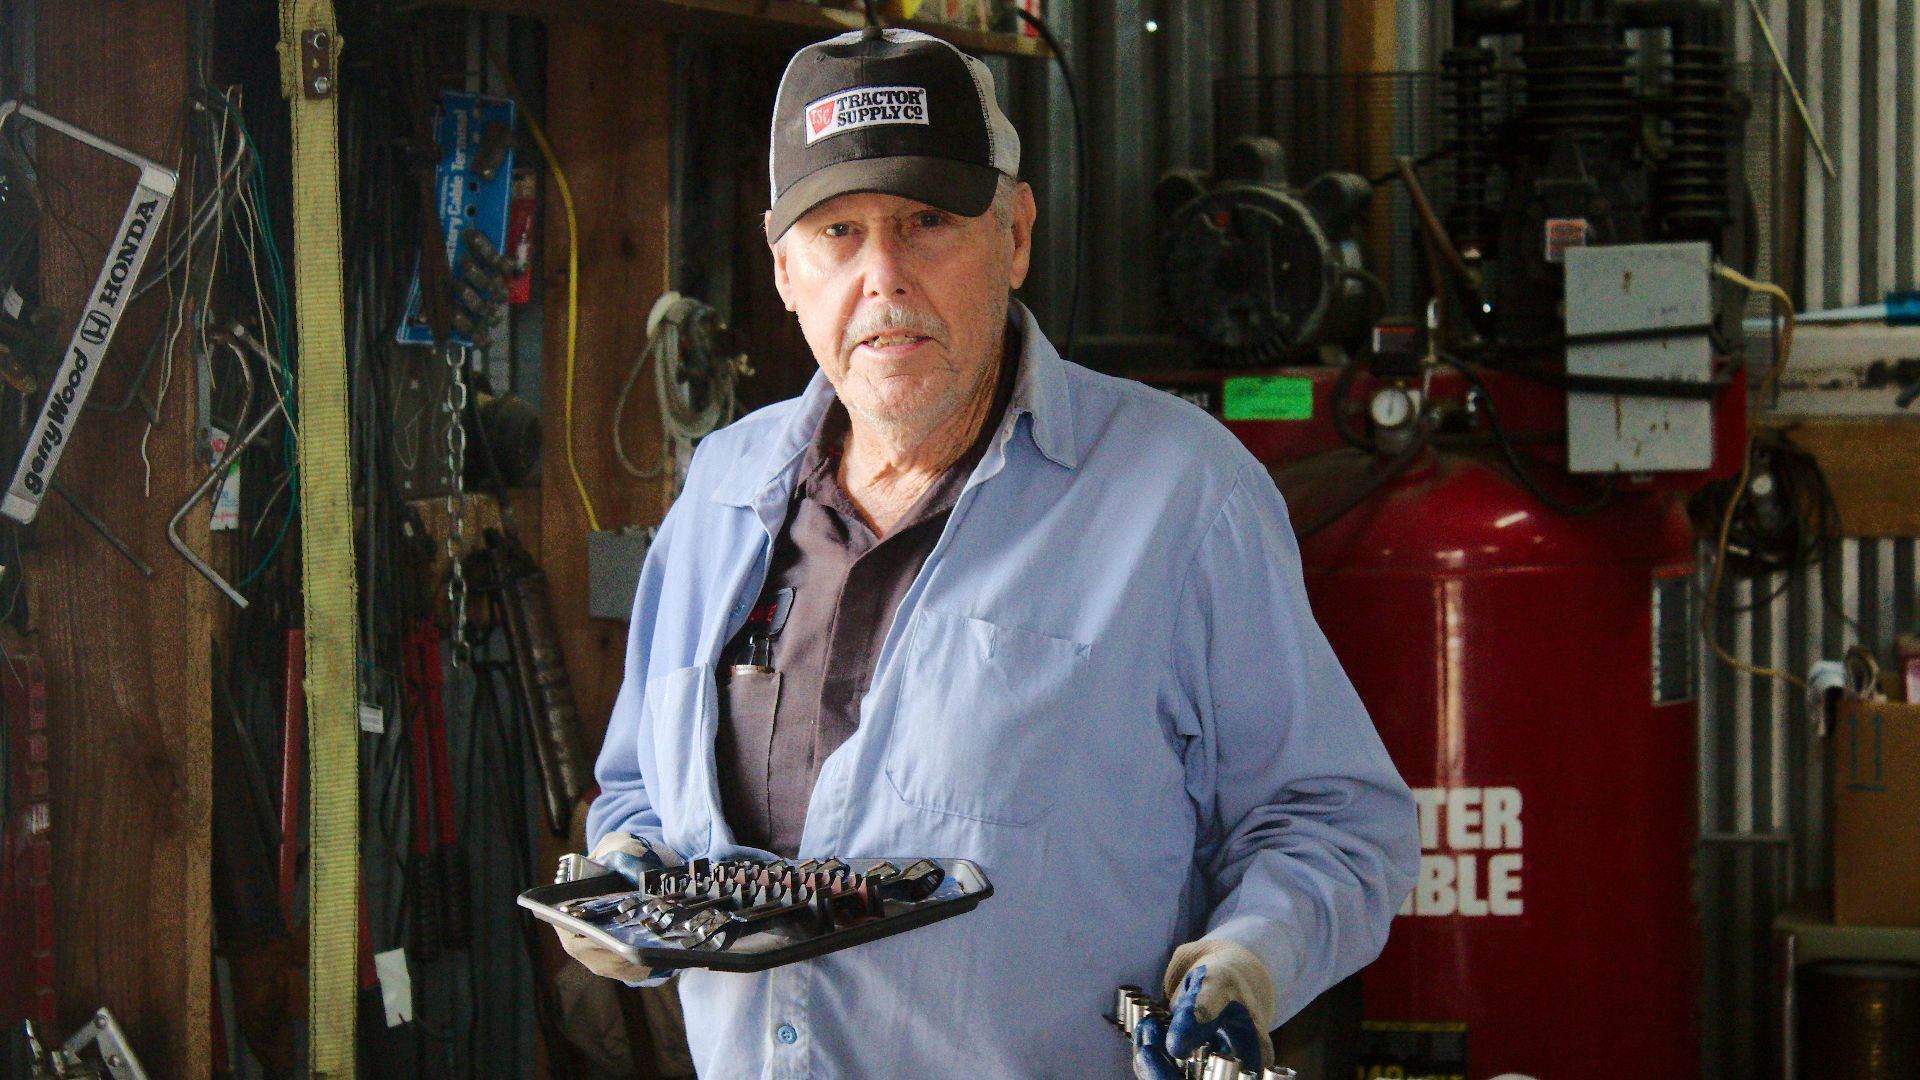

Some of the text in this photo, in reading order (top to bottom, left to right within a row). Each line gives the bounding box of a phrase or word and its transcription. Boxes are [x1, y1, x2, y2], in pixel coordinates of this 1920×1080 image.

[836, 90, 922, 112] TRACTOR
[837, 106, 902, 127] SUPPLY
[810, 108, 831, 126] TSC
[448, 175, 463, 216] Cable
[98, 198, 159, 308] HONDA
[446, 217, 463, 270] attery
